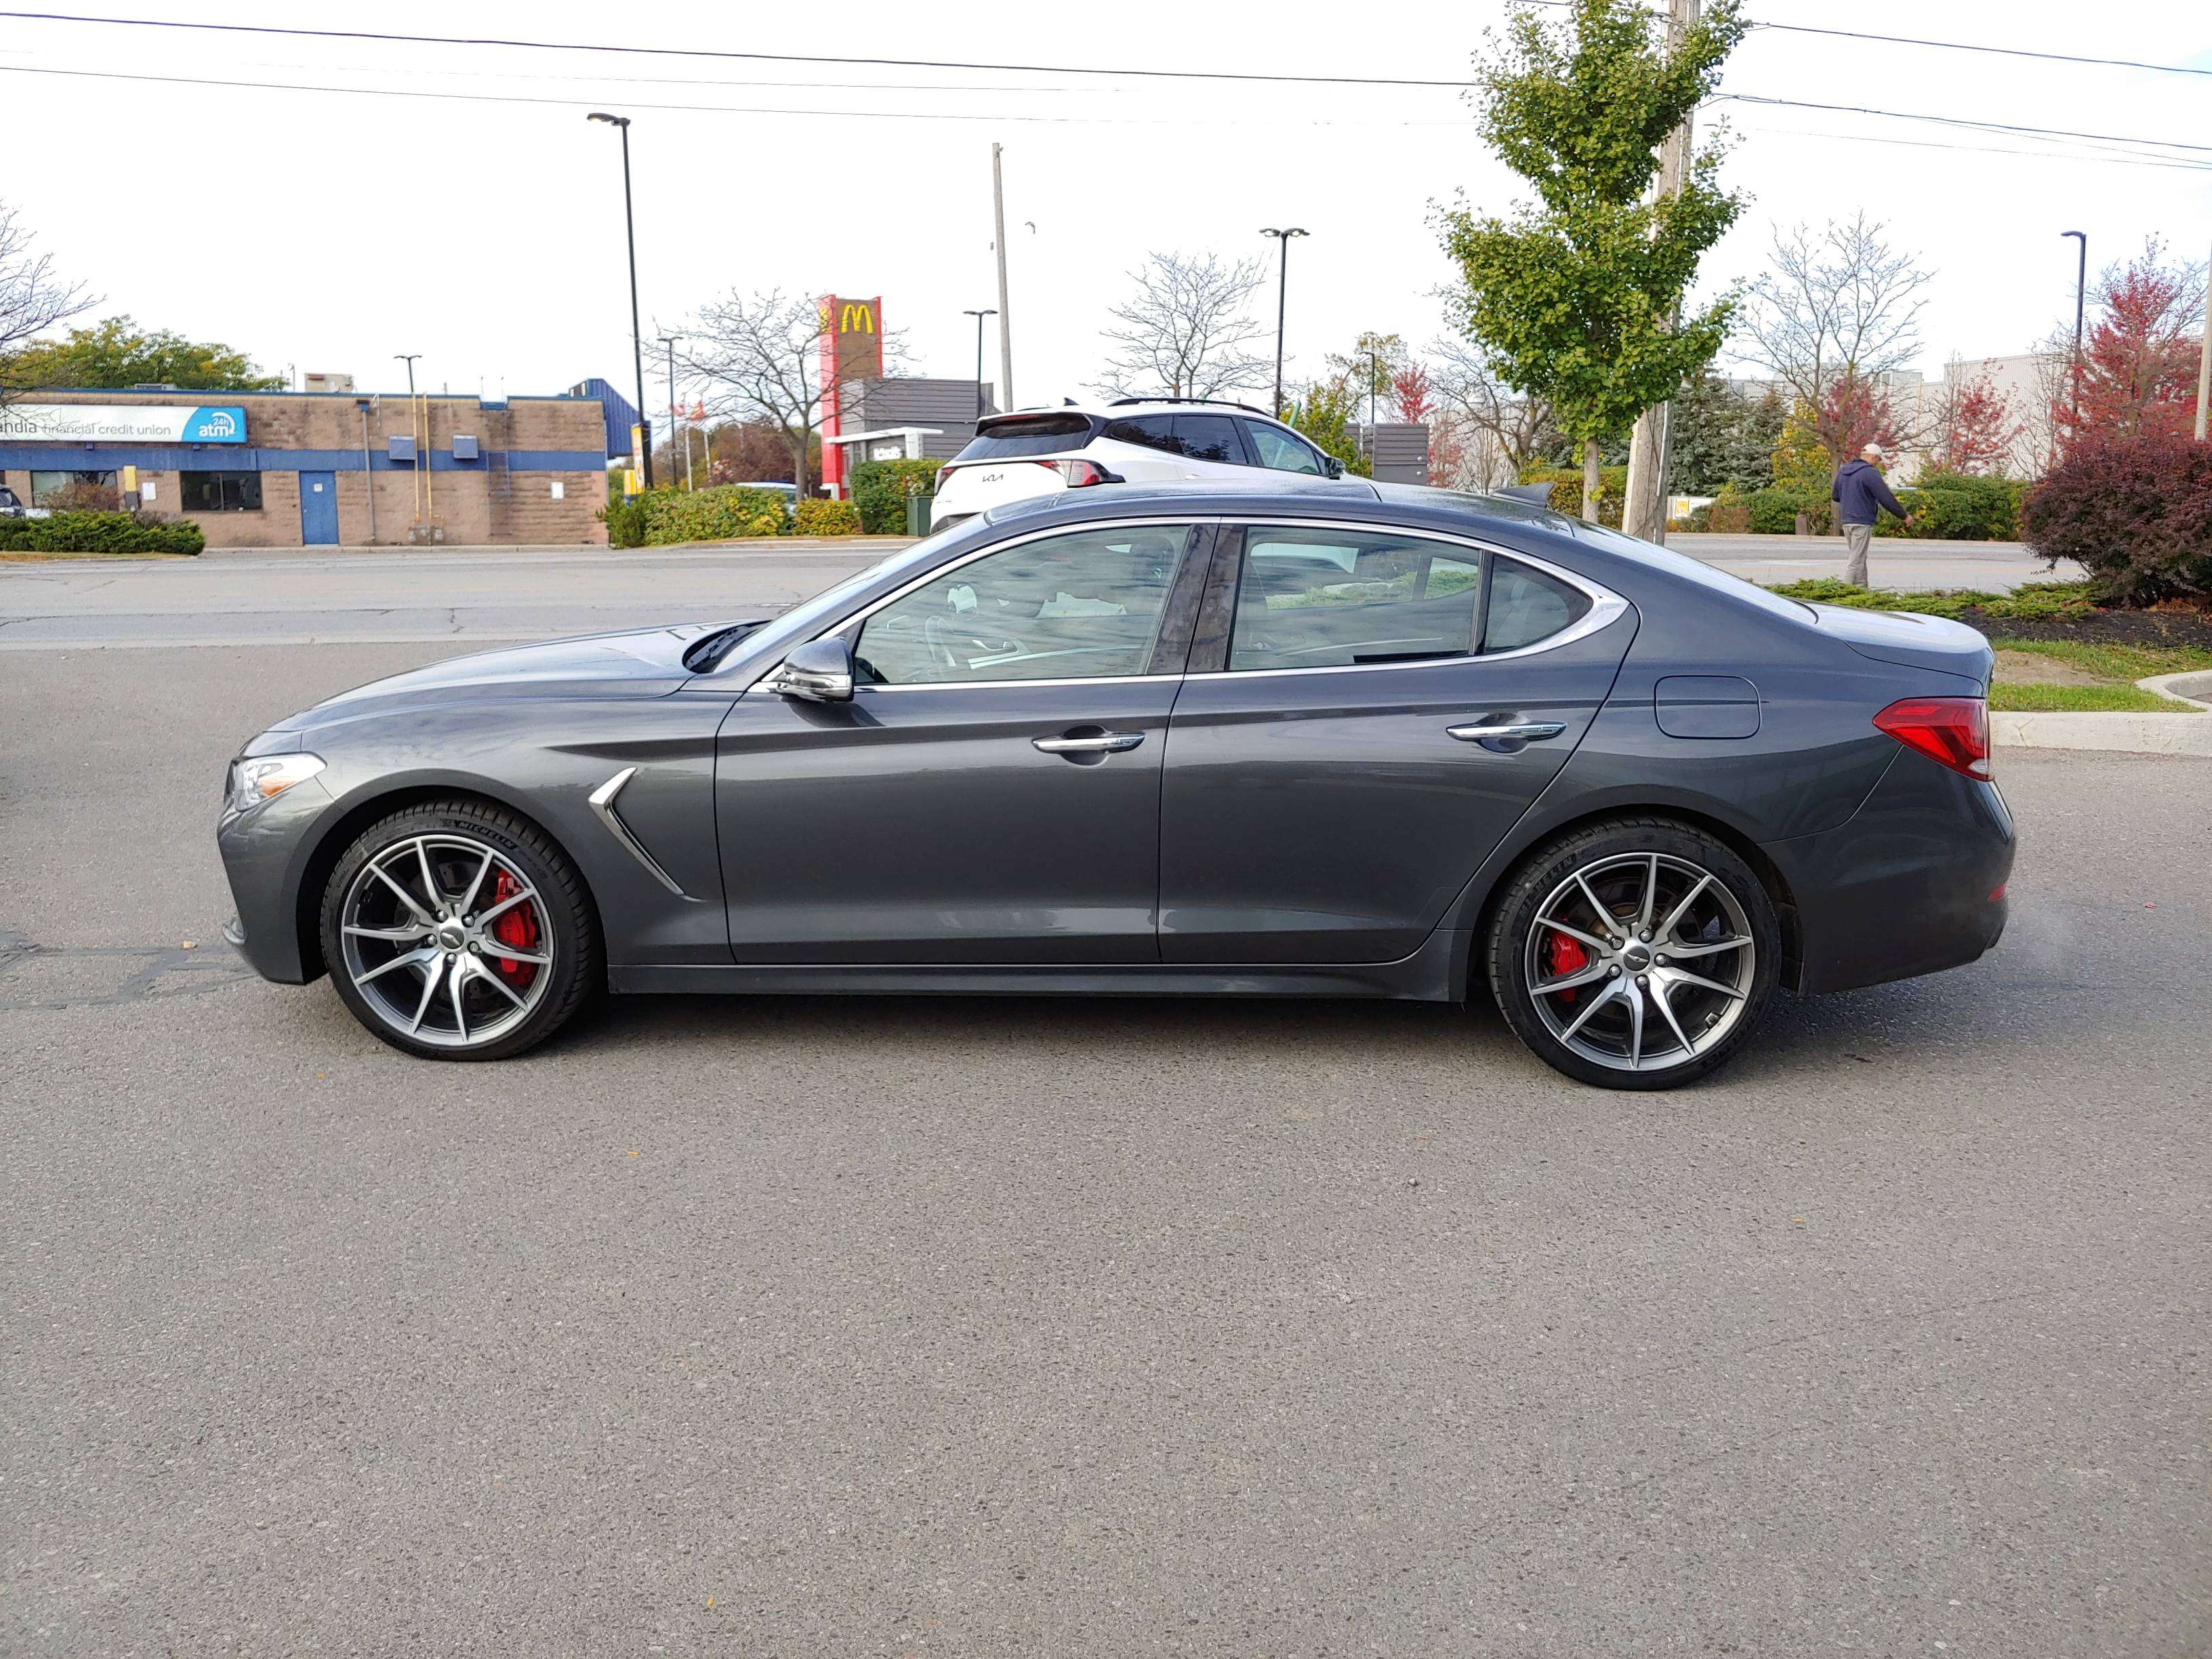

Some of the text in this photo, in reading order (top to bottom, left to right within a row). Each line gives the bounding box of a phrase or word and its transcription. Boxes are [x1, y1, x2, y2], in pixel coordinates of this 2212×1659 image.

[213, 417, 229, 426] 24h
[43, 423, 95, 434] financial
[98, 423, 134, 435] credit
[138, 424, 171, 435] union
[199, 426, 229, 437] atm
[458, 821, 515, 848] MICHELIN
